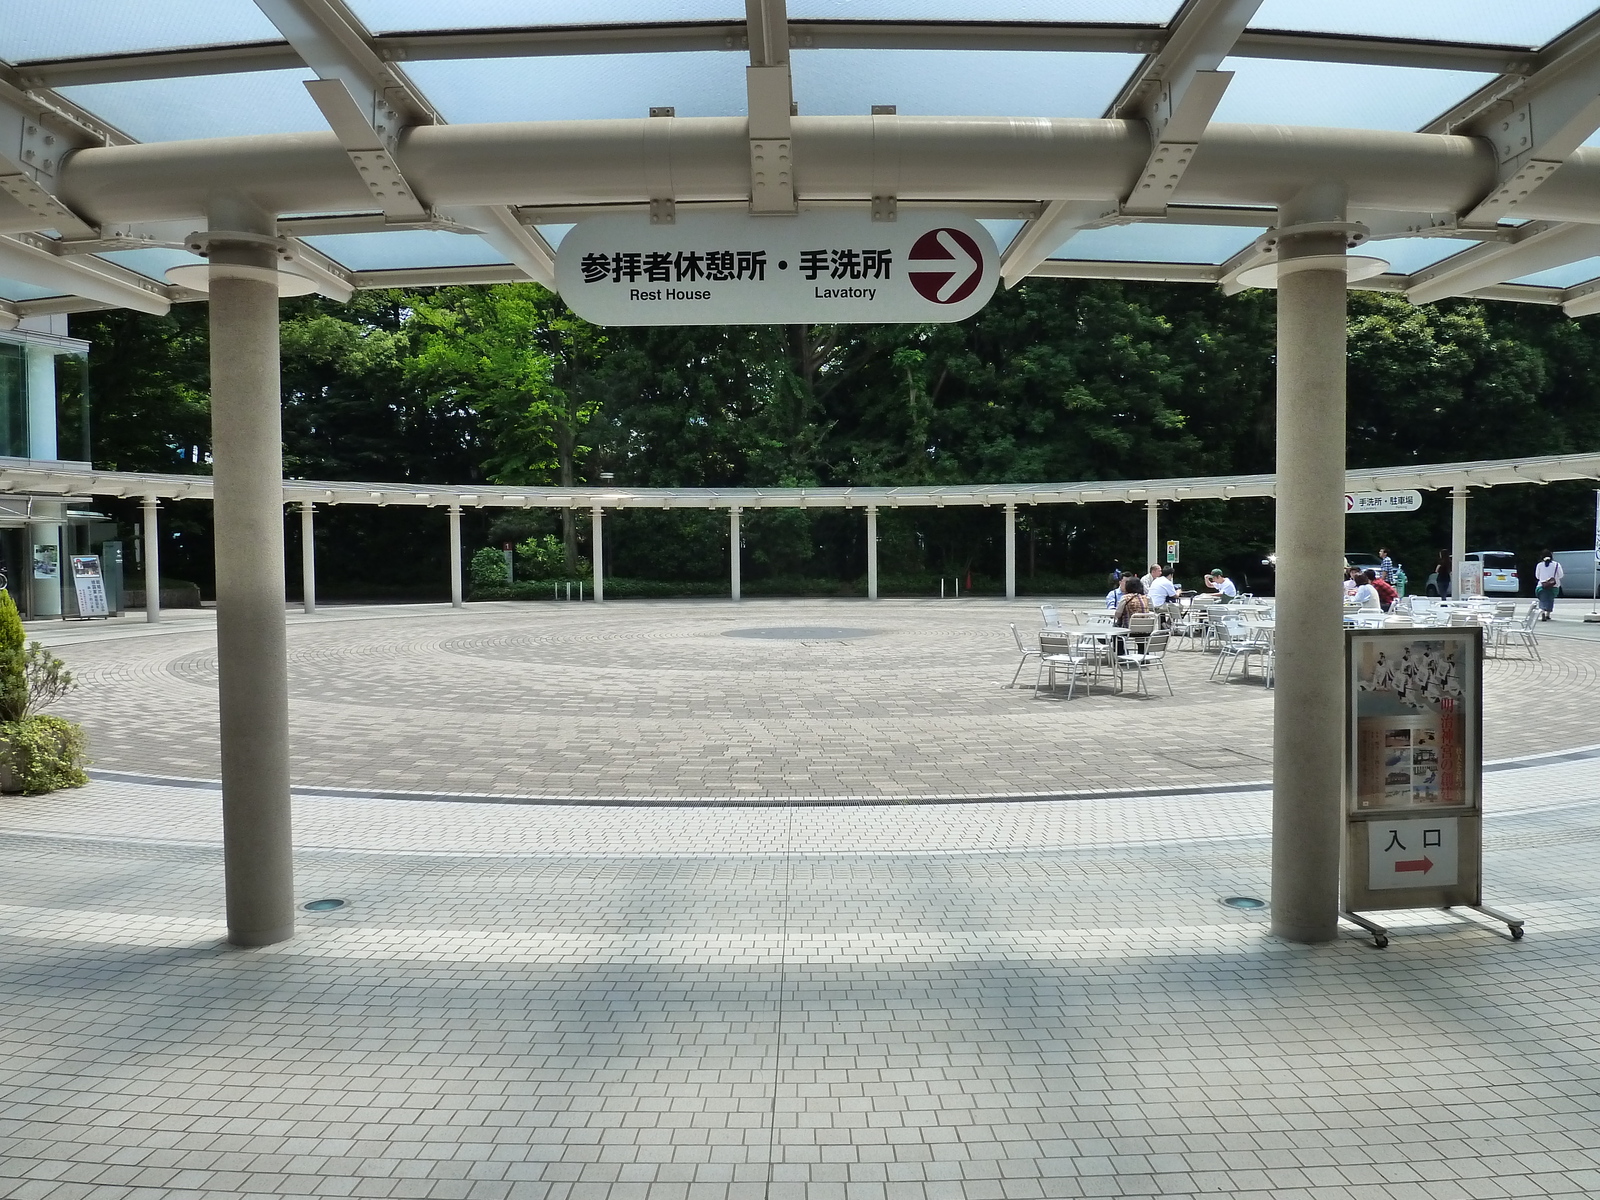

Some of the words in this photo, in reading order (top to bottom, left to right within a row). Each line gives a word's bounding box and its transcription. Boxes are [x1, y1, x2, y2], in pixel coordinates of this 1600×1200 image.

[581, 249, 893, 283] 参拝者休憩所・手洗所
[630, 289, 662, 301] Rest
[666, 288, 711, 300] House
[815, 286, 876, 300] Lavatory
[1384, 829, 1441, 852] 入口
